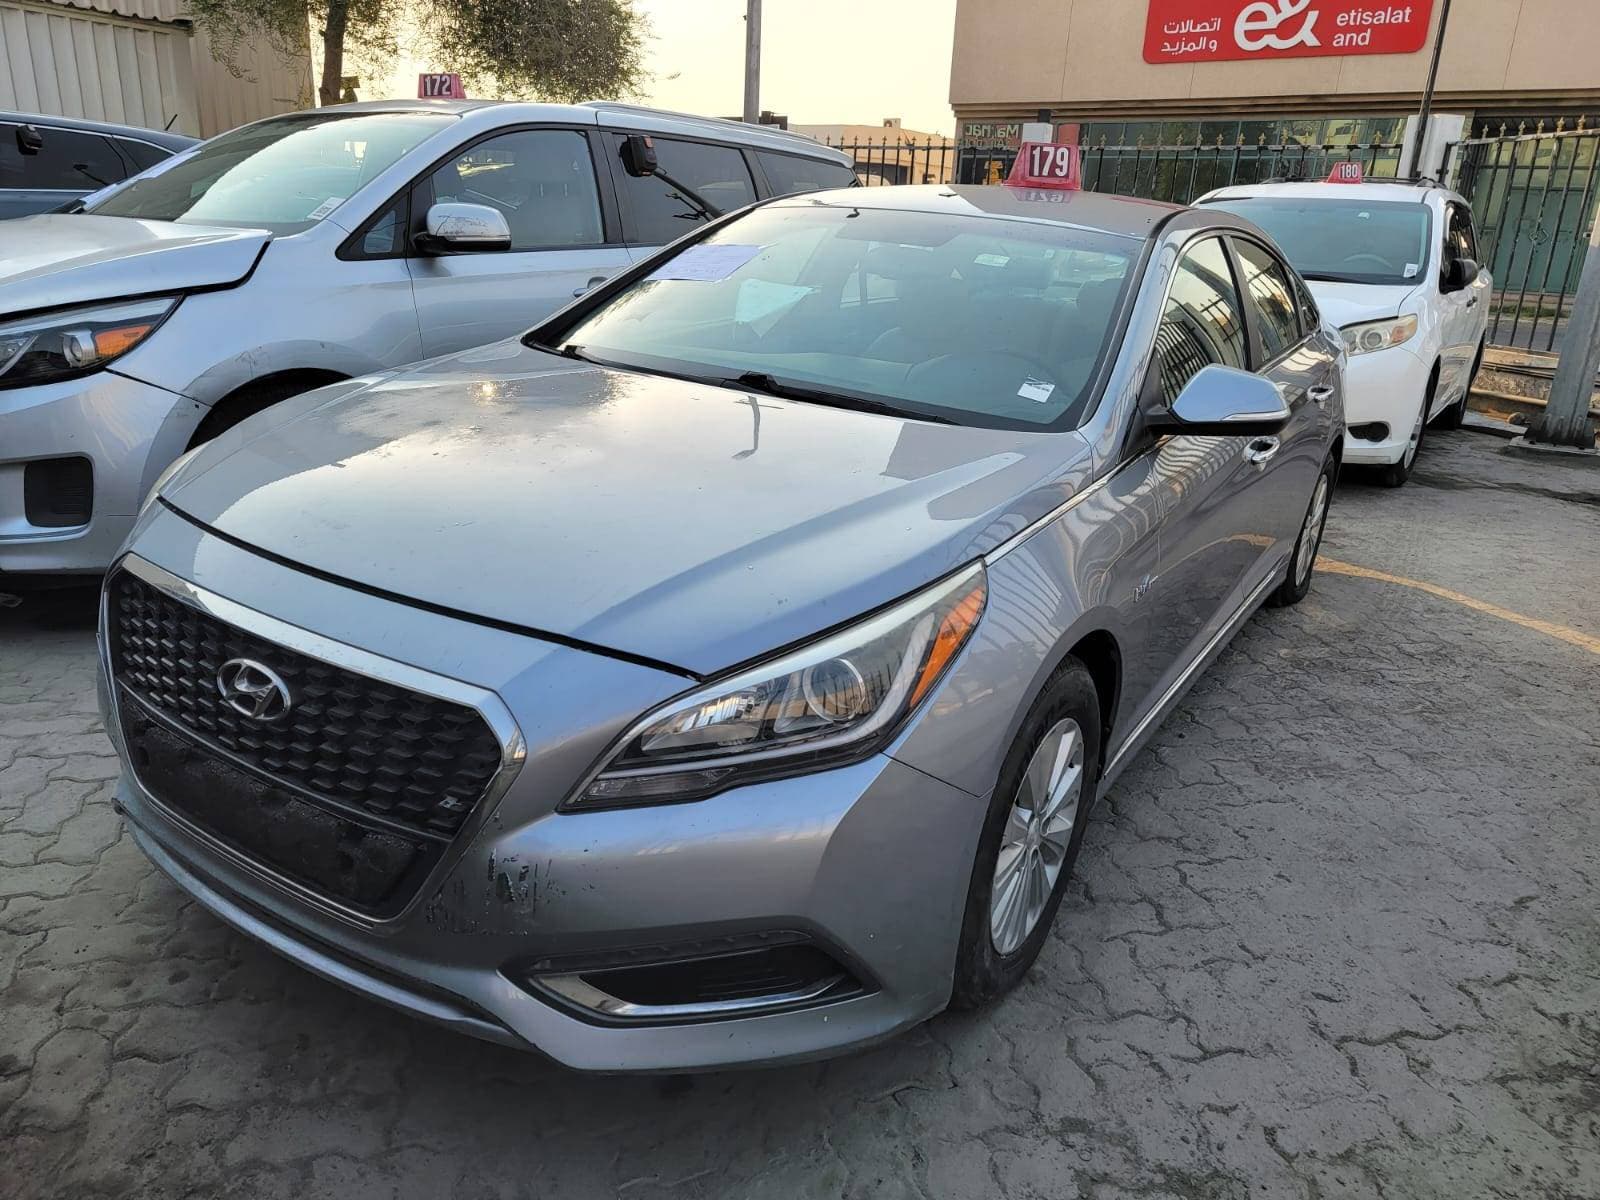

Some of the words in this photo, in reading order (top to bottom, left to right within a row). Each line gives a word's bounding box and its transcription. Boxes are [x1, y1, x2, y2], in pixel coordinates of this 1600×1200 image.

[1163, 17, 1221, 34] اتصالات
[1336, 6, 1412, 27] etisalat
[1332, 28, 1371, 48] and
[424, 74, 451, 96] 172
[1032, 146, 1069, 177] 179
[1341, 164, 1358, 178] 180
